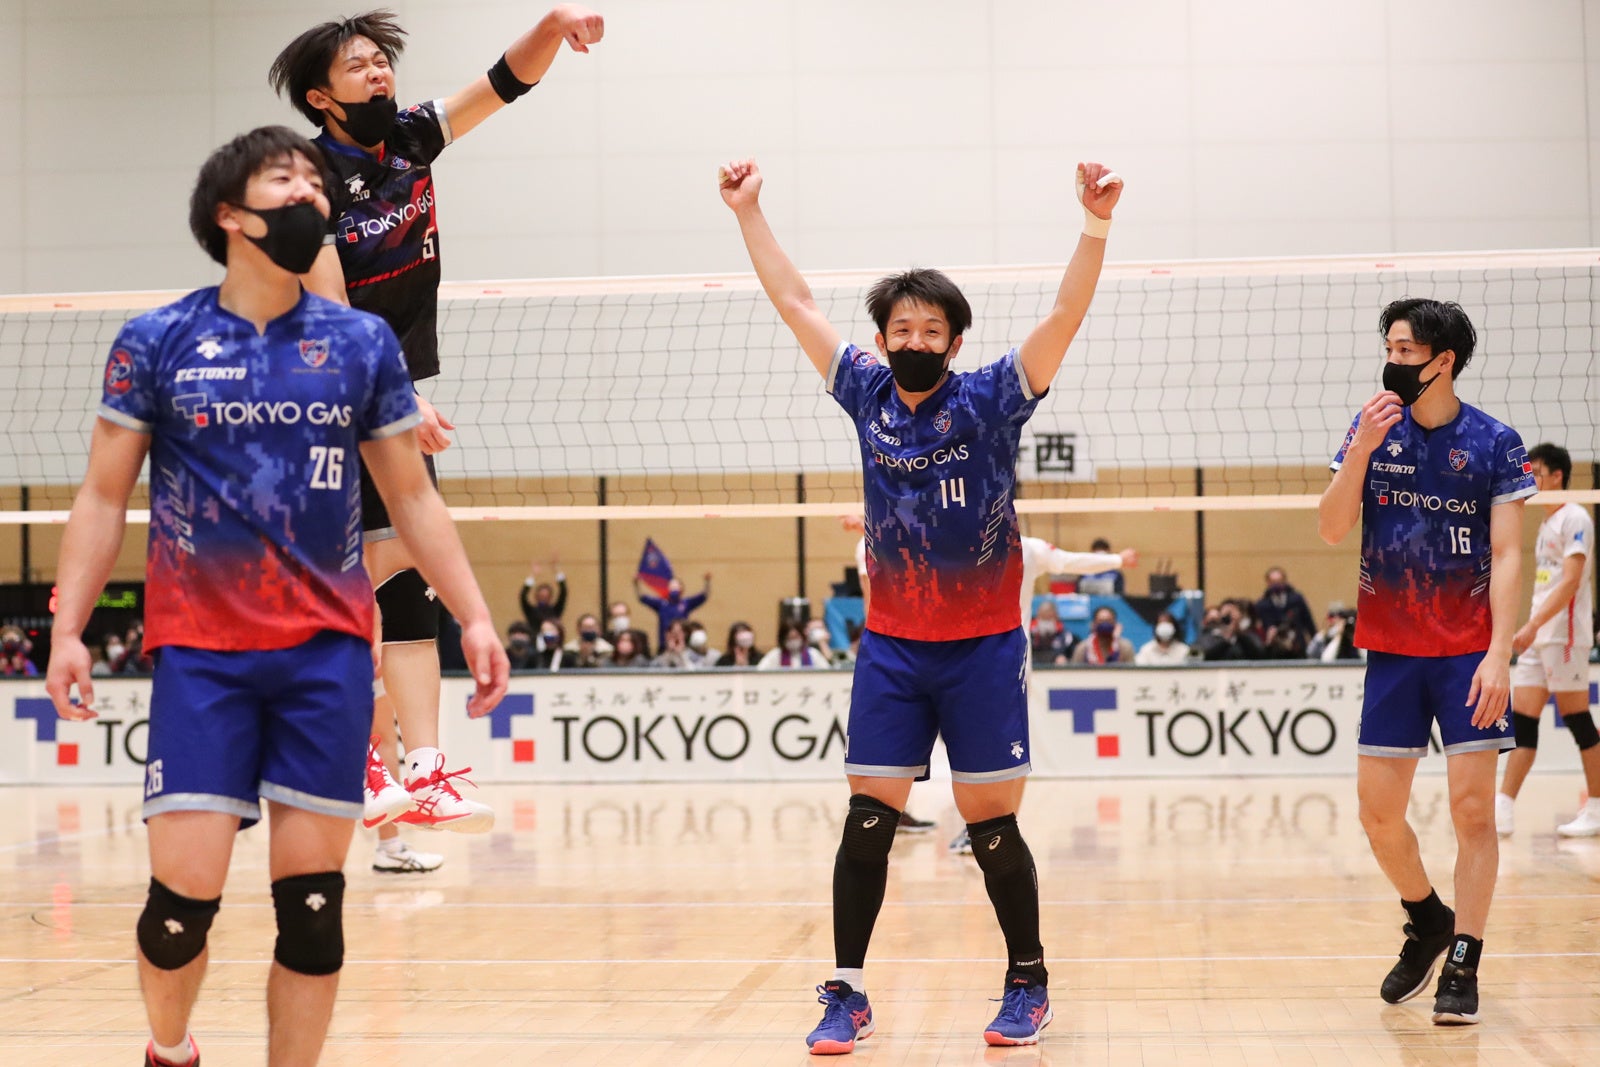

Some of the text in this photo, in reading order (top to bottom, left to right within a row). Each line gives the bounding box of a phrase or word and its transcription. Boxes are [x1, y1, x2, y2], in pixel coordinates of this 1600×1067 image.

[357, 189, 434, 238] TOKYO GAS
[422, 226, 435, 259] 5
[211, 401, 352, 427] TOKYO GAS
[309, 445, 345, 490] 26
[932, 444, 970, 465] GAS
[939, 477, 966, 509] 14
[1391, 490, 1477, 515] TOKYO GAS
[1449, 526, 1472, 554] 16
[552, 714, 751, 763] TOKYO
[1136, 709, 1337, 757] TOKYO
